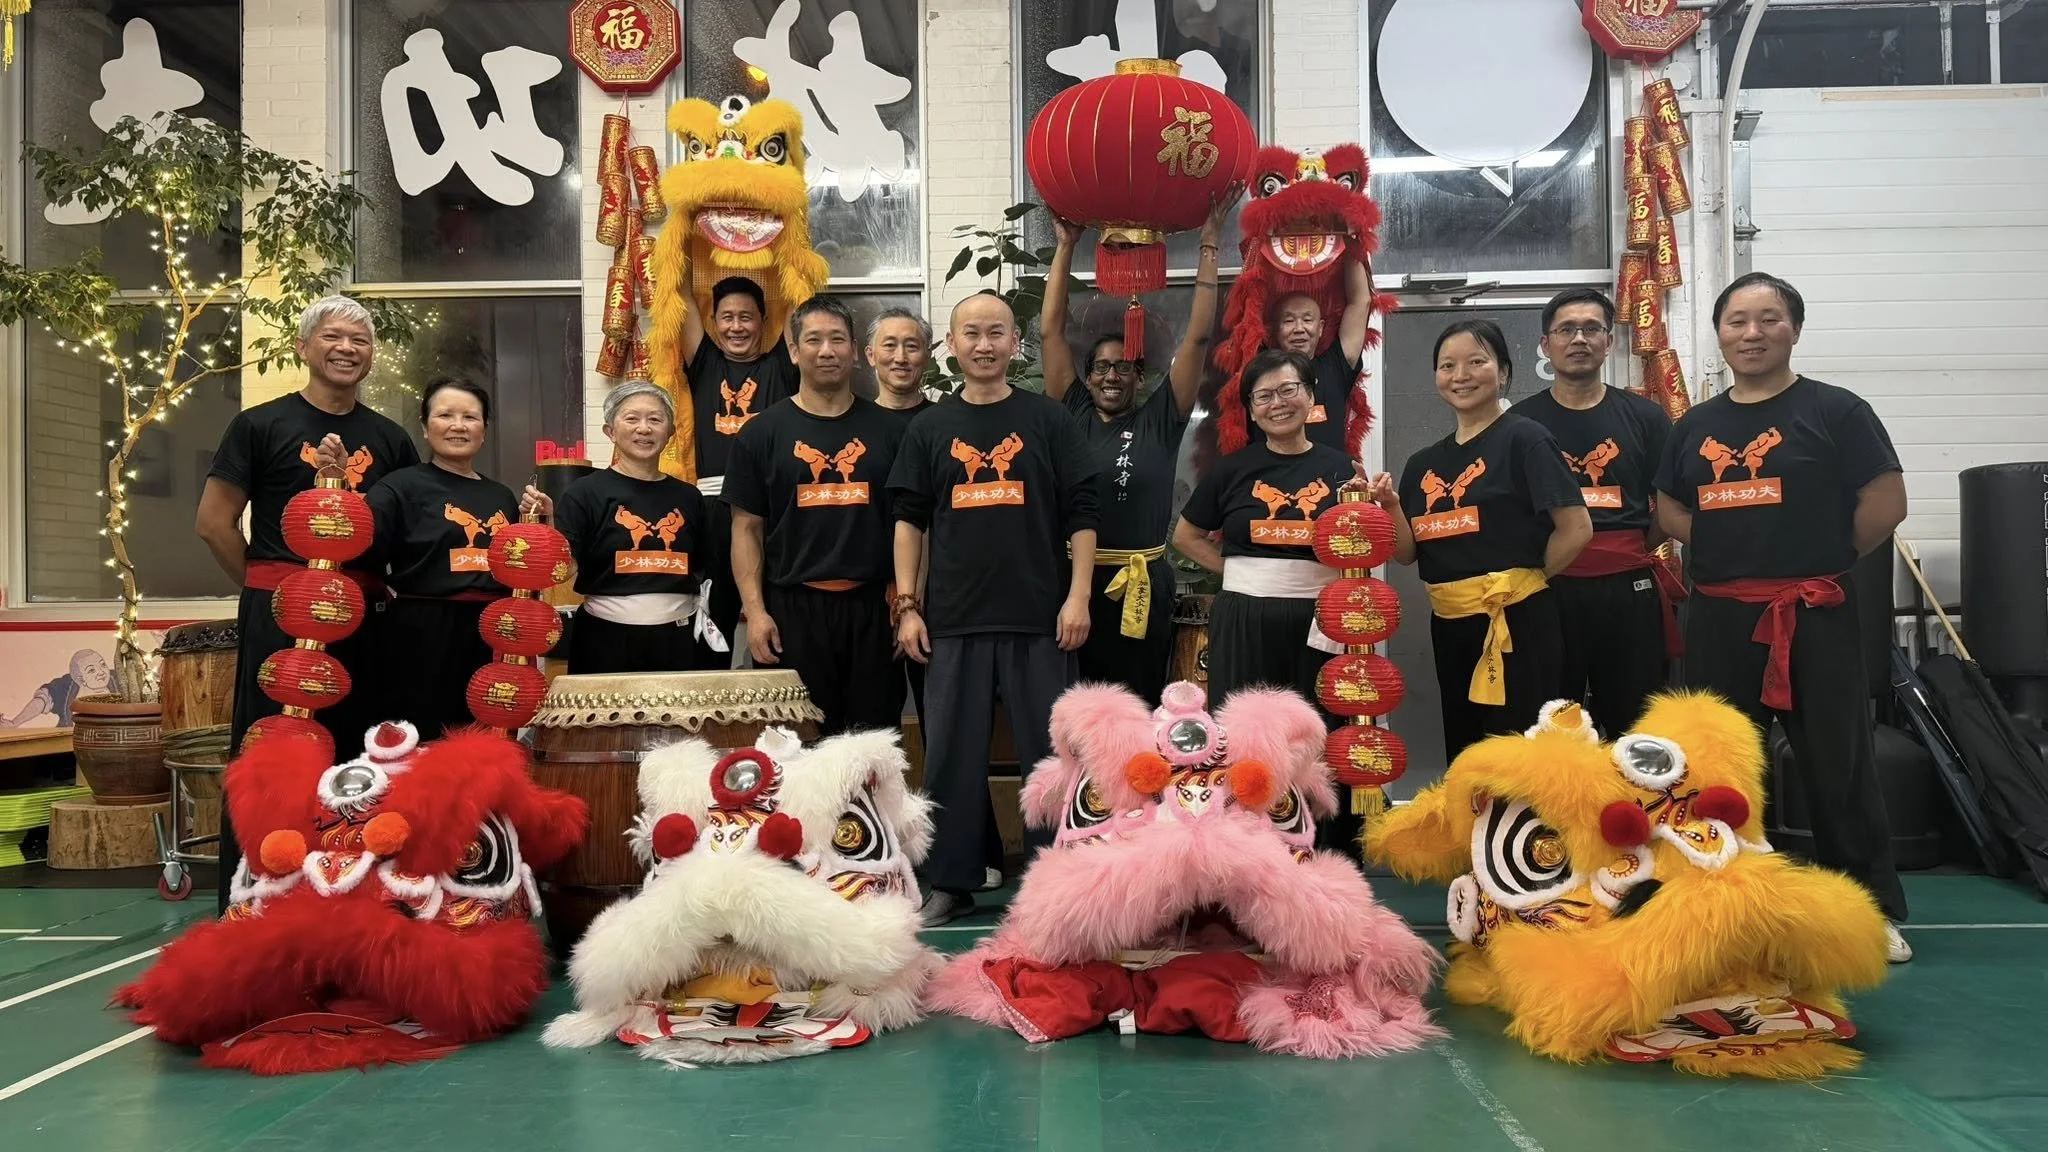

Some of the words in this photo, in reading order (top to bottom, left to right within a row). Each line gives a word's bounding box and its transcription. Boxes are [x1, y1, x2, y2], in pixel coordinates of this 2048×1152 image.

[599, 6, 645, 50] 福
[1156, 106, 1220, 179] 福
[799, 487, 867, 502] 少林功夫
[953, 487, 1023, 503] 少林功夫
[1701, 485, 1779, 504] 少林功夫
[1415, 514, 1477, 537] 少林功夫
[617, 556, 687, 570] 少林功夫
